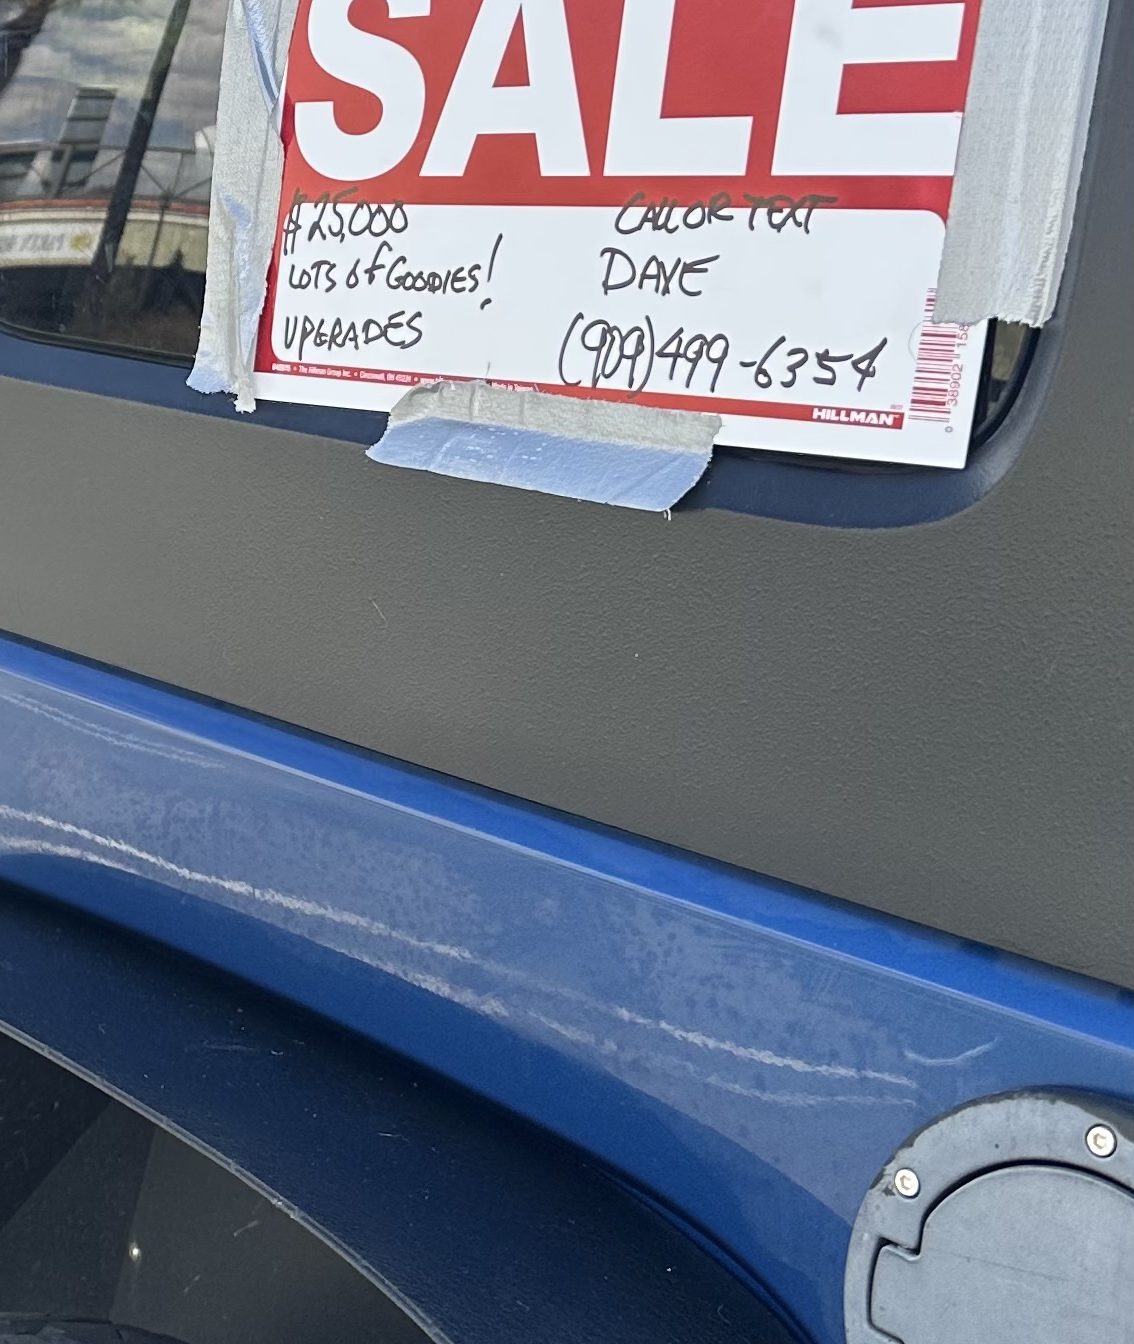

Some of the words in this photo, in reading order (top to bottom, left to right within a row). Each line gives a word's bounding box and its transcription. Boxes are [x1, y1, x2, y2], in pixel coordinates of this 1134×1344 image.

[283, 186, 409, 256] $25,000
[742, 192, 839, 235] TEXT
[288, 258, 338, 294] LOTS
[599, 246, 721, 297] DAVE
[283, 310, 424, 362] UPGRADES
[812, 407, 895, 427] HILLMAN
